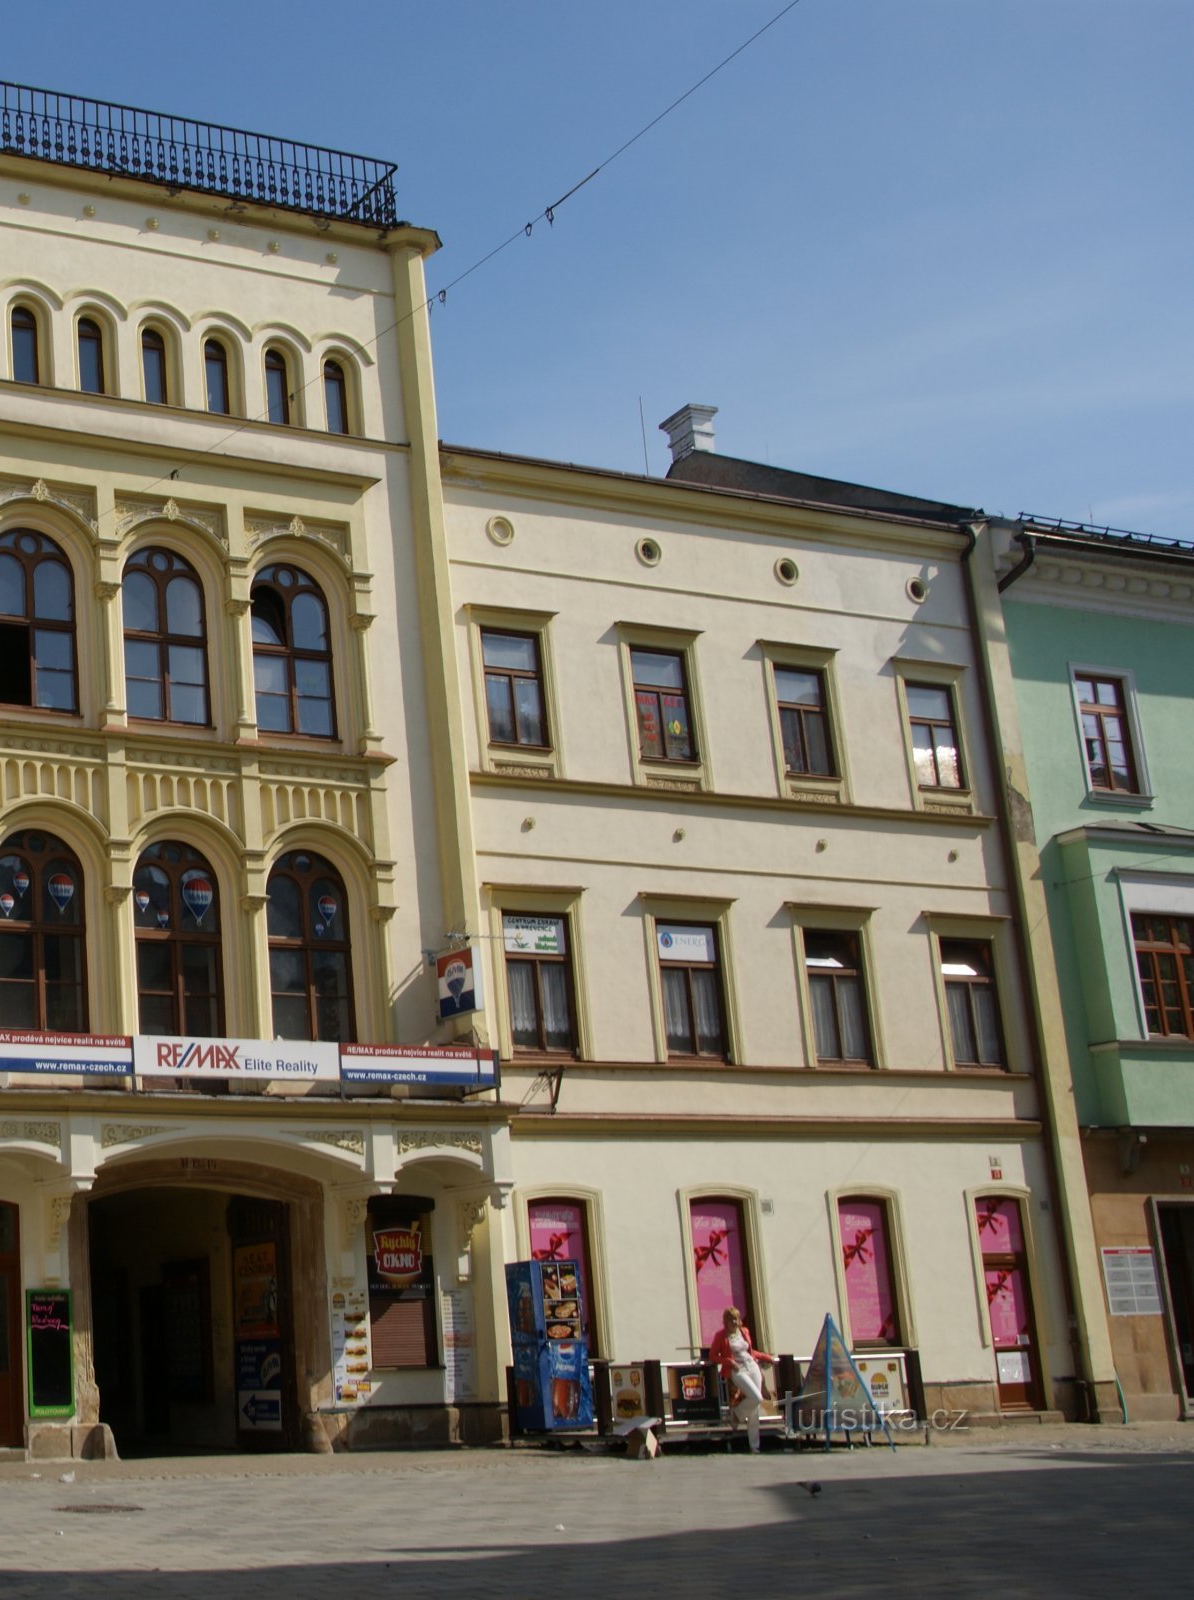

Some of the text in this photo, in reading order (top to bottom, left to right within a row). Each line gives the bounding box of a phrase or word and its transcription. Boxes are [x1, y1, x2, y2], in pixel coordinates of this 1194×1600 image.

[507, 917, 536, 925] CENTRUM
[674, 934, 711, 946] ENERGY
[12, 1034, 44, 1045] prodává
[44, 1036, 73, 1047] nejvíce
[73, 1037, 94, 1046] realit
[105, 1037, 126, 1047] světě
[156, 1042, 319, 1075] RE/MAX Elite Reality
[346, 1046, 374, 1055] RE/MAX
[374, 1047, 403, 1057] prodává
[403, 1048, 427, 1059] nejvíce
[427, 1049, 445, 1058] realit
[454, 1050, 472, 1059] světě
[35, 1061, 127, 1073] www.remax-czech.cz
[346, 1071, 427, 1082] www.remax-czech.cz
[383, 1252, 415, 1269] OKNO
